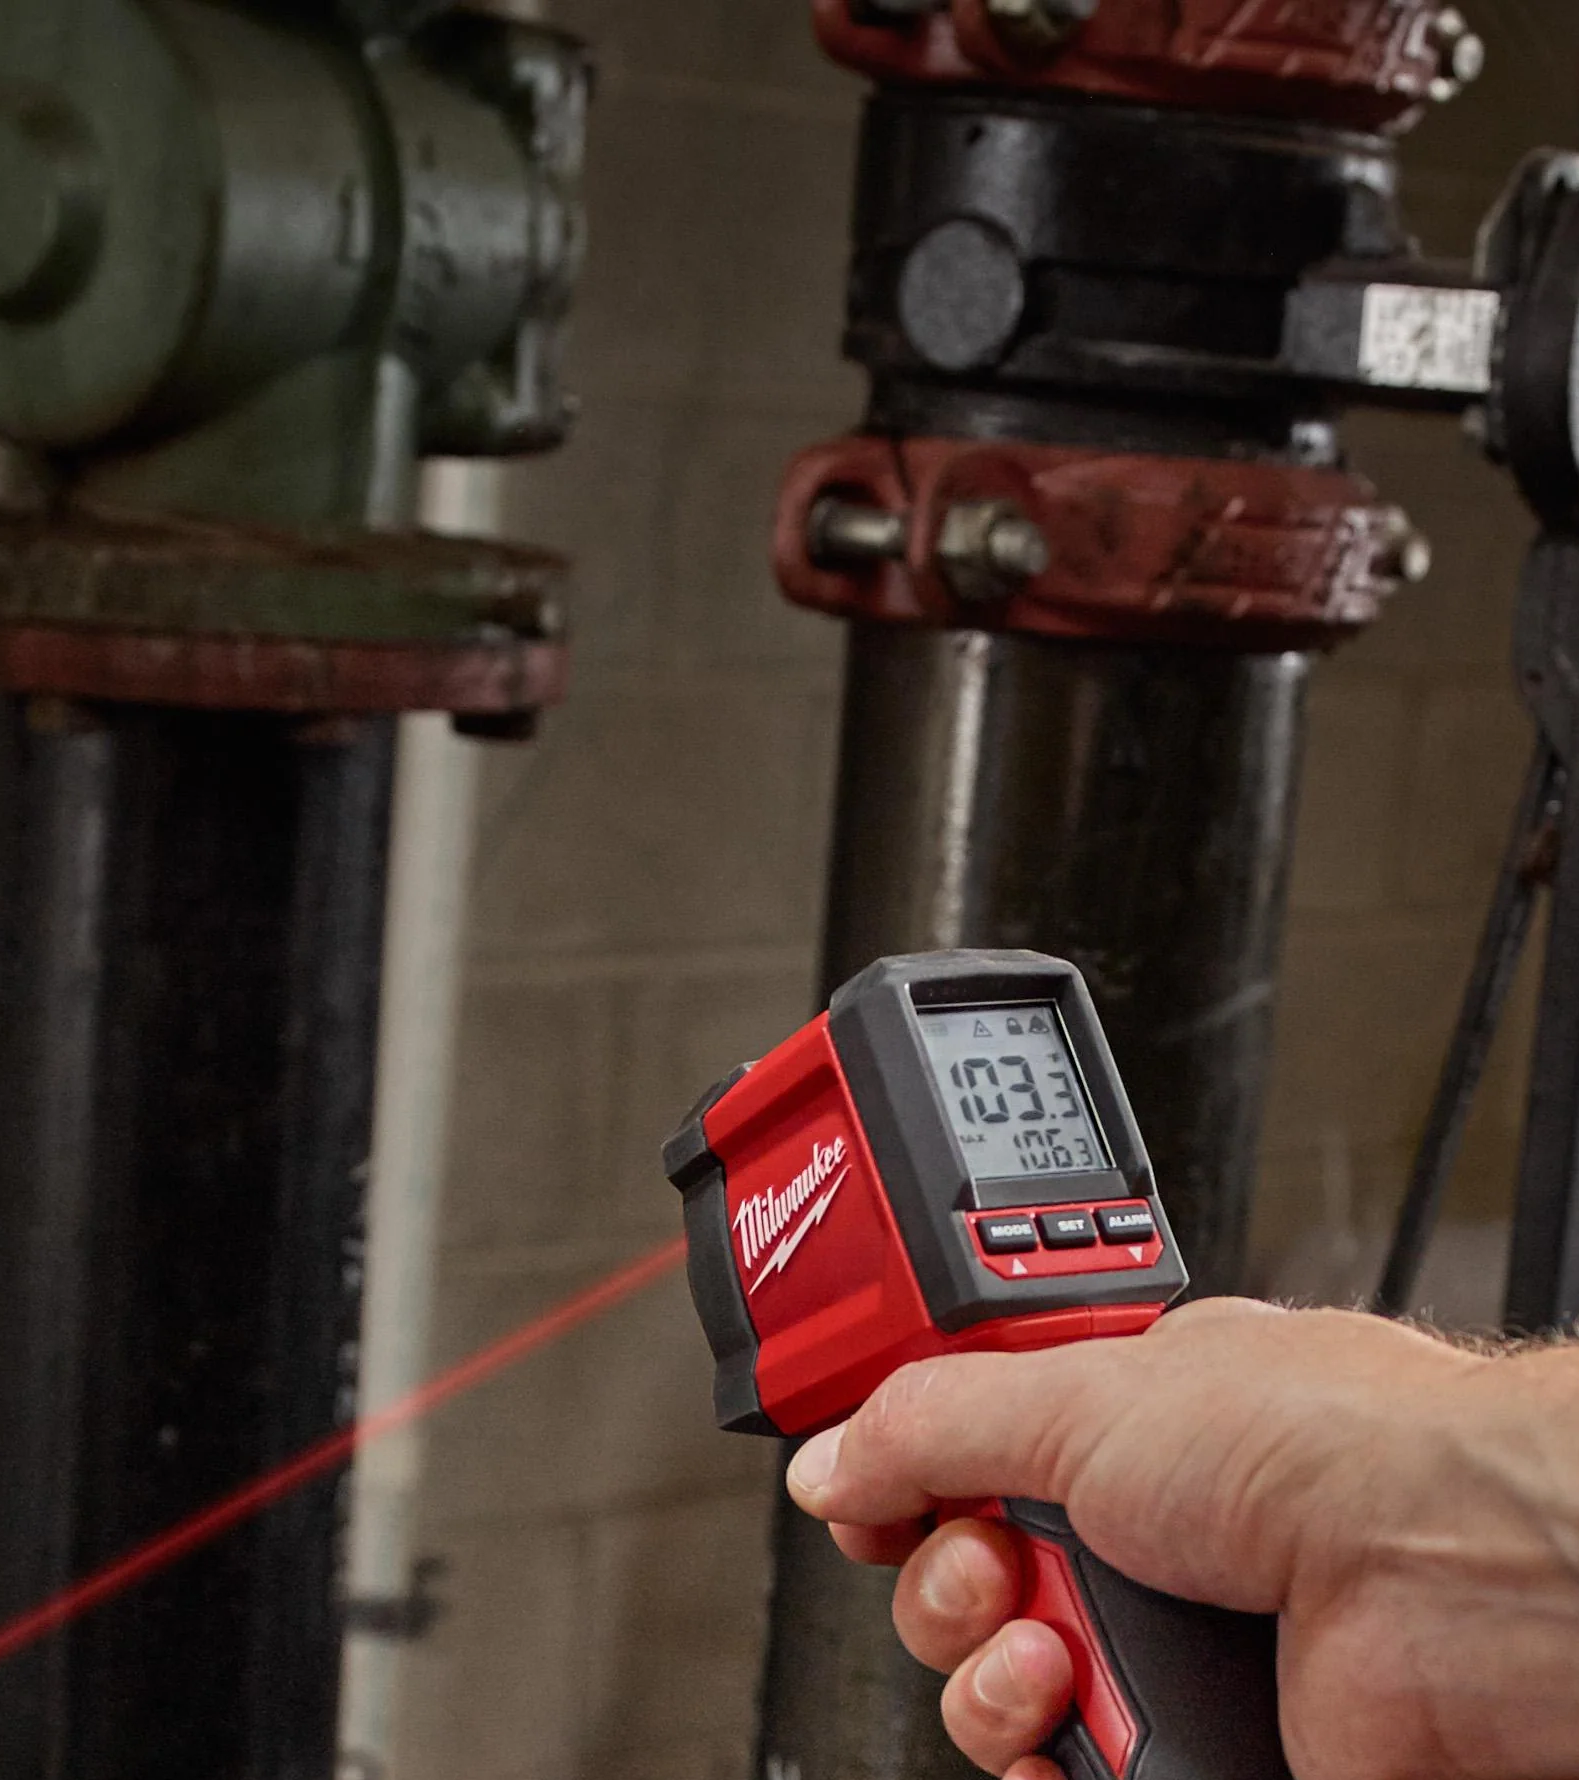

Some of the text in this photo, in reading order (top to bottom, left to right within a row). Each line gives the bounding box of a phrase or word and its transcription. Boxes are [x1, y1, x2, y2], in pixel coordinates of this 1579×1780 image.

[949, 1054, 1081, 1125] 103.3
[1013, 1127, 1094, 1171] 106.3
[732, 1135, 848, 1269] Milwaukee
[990, 1222, 1033, 1238] MODE
[1057, 1218, 1085, 1232] SET
[1108, 1212, 1153, 1228] ALARM
